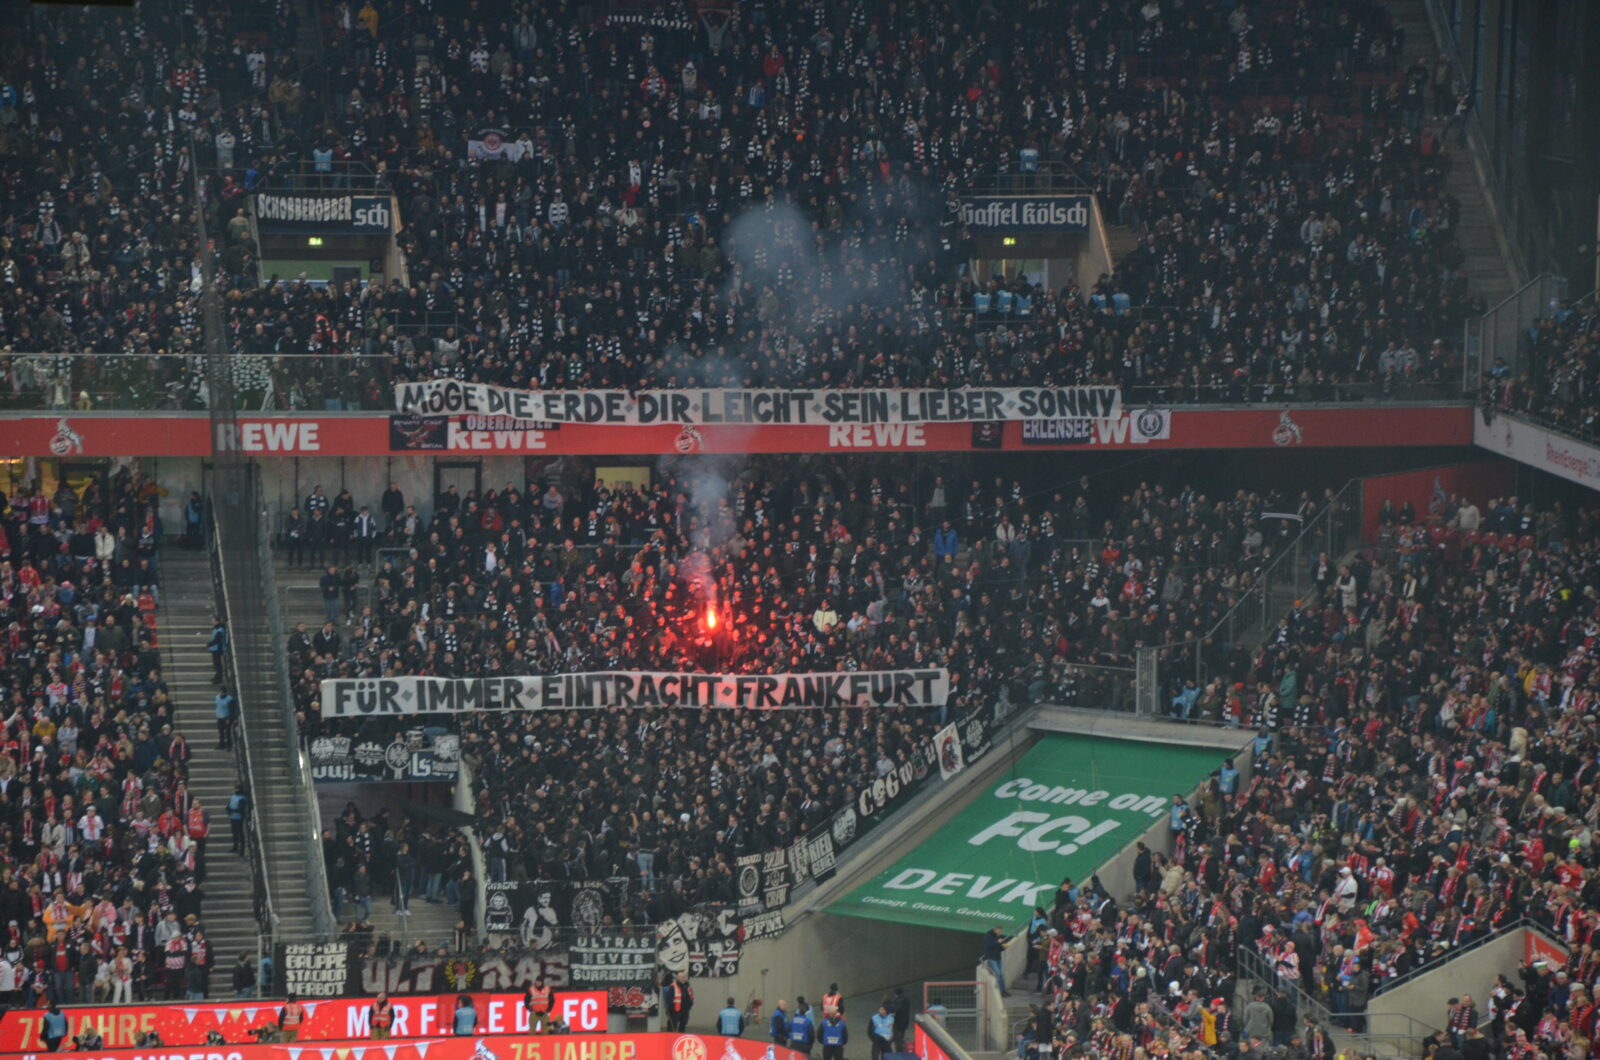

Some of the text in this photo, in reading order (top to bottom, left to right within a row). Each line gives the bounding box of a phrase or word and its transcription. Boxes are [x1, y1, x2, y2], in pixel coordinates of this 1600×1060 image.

[401, 381, 1117, 424] MÖGE DIE ERDE DIR LEICHT SEIN LIEBER SONNY
[217, 423, 320, 451] REWE
[829, 423, 927, 447] REWE
[1023, 419, 1090, 439] ERLENSEE
[334, 671, 940, 714] FÜR IMMER EINTRACHT FRANKFURT
[994, 778, 1110, 806] Come
[967, 811, 1121, 856] FC!
[882, 868, 1058, 907] DEVK
[577, 937, 650, 949] ULTRAS
[285, 954, 347, 969] GRUPPE
[582, 952, 645, 965] NEVER
[286, 968, 347, 982] STADION
[572, 969, 652, 982] SURRENDER
[286, 981, 346, 996] VERBOT
[347, 1005, 409, 1038] MR
